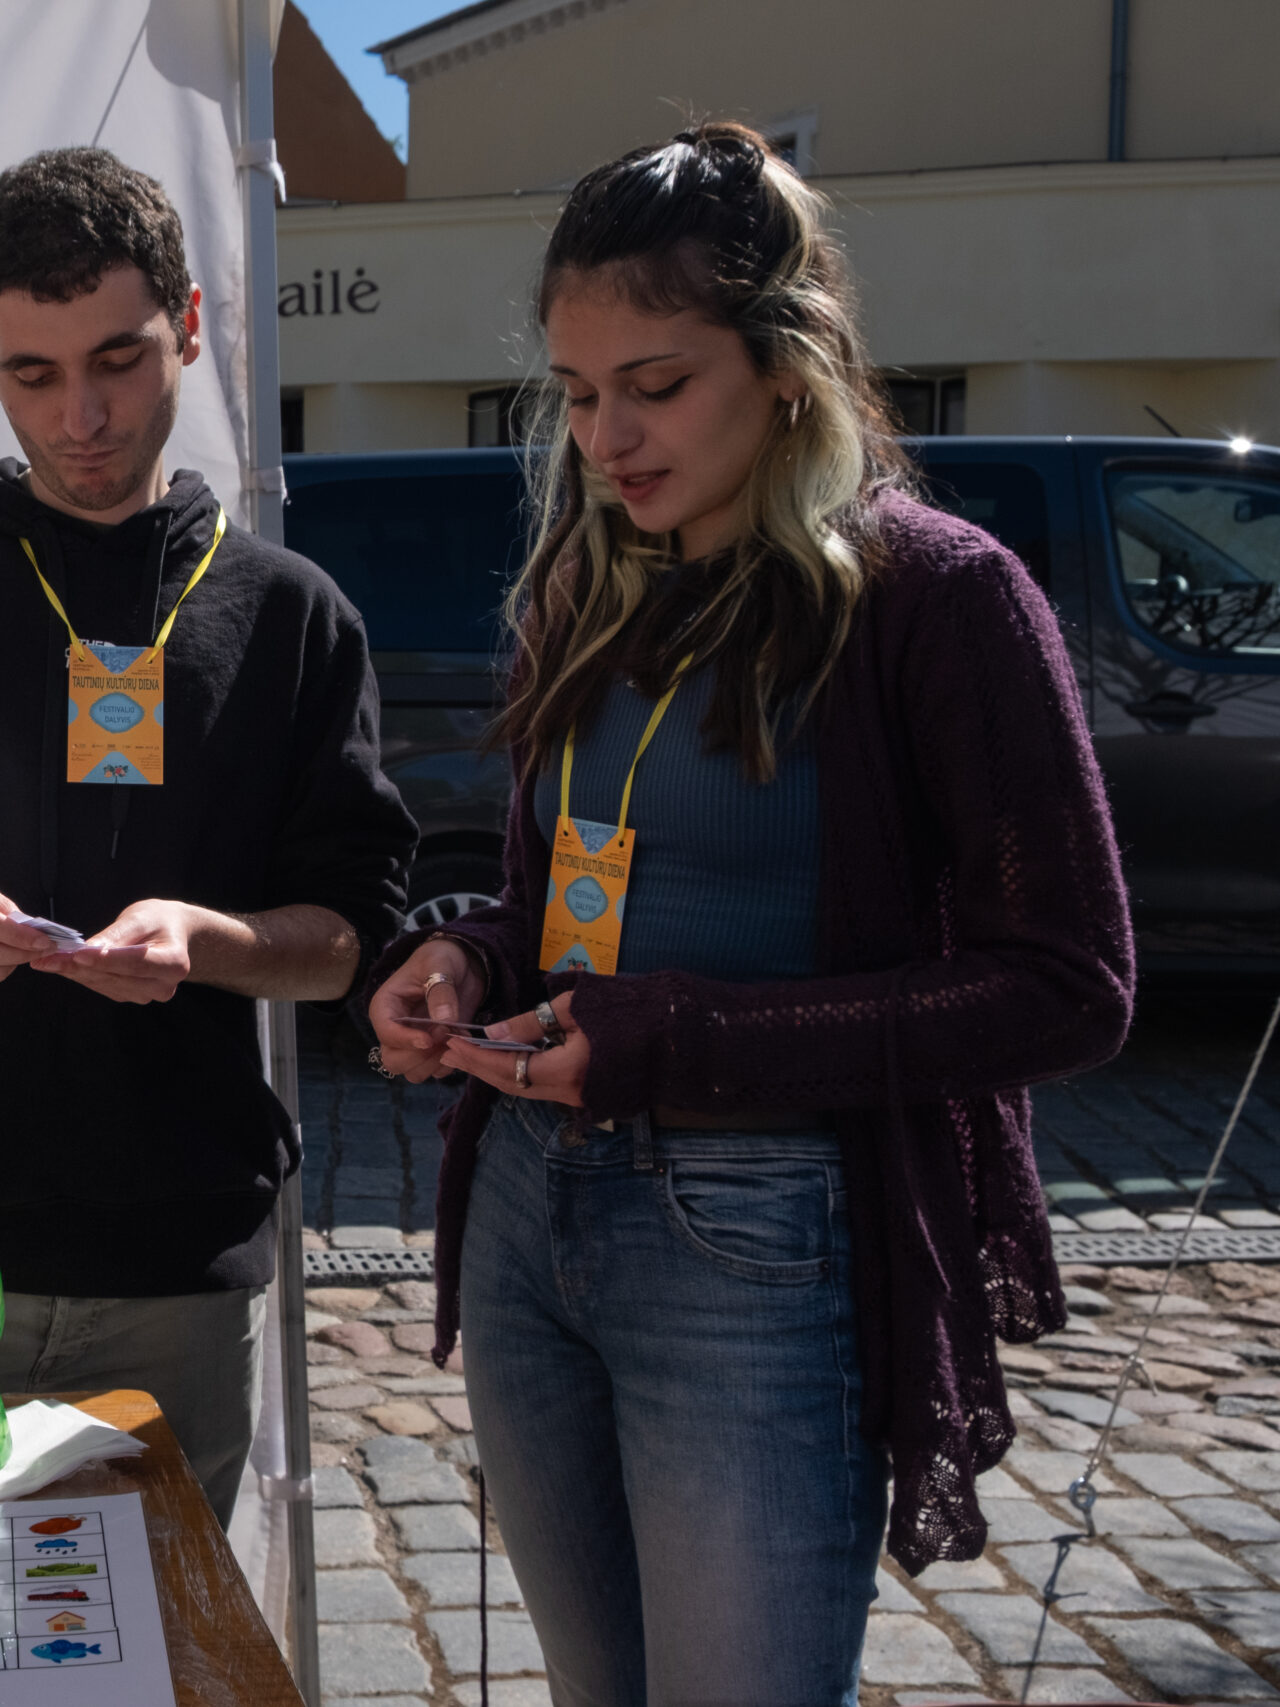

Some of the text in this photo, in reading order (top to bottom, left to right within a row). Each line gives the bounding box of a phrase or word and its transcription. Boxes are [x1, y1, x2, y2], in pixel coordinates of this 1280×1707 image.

[72, 675, 159, 692] TAUTINIŲ KULTŪRŲ DIENA
[99, 705, 135, 714] FESTIVALIO
[104, 715, 131, 723] DALYVIS
[607, 863, 625, 880] DIENA
